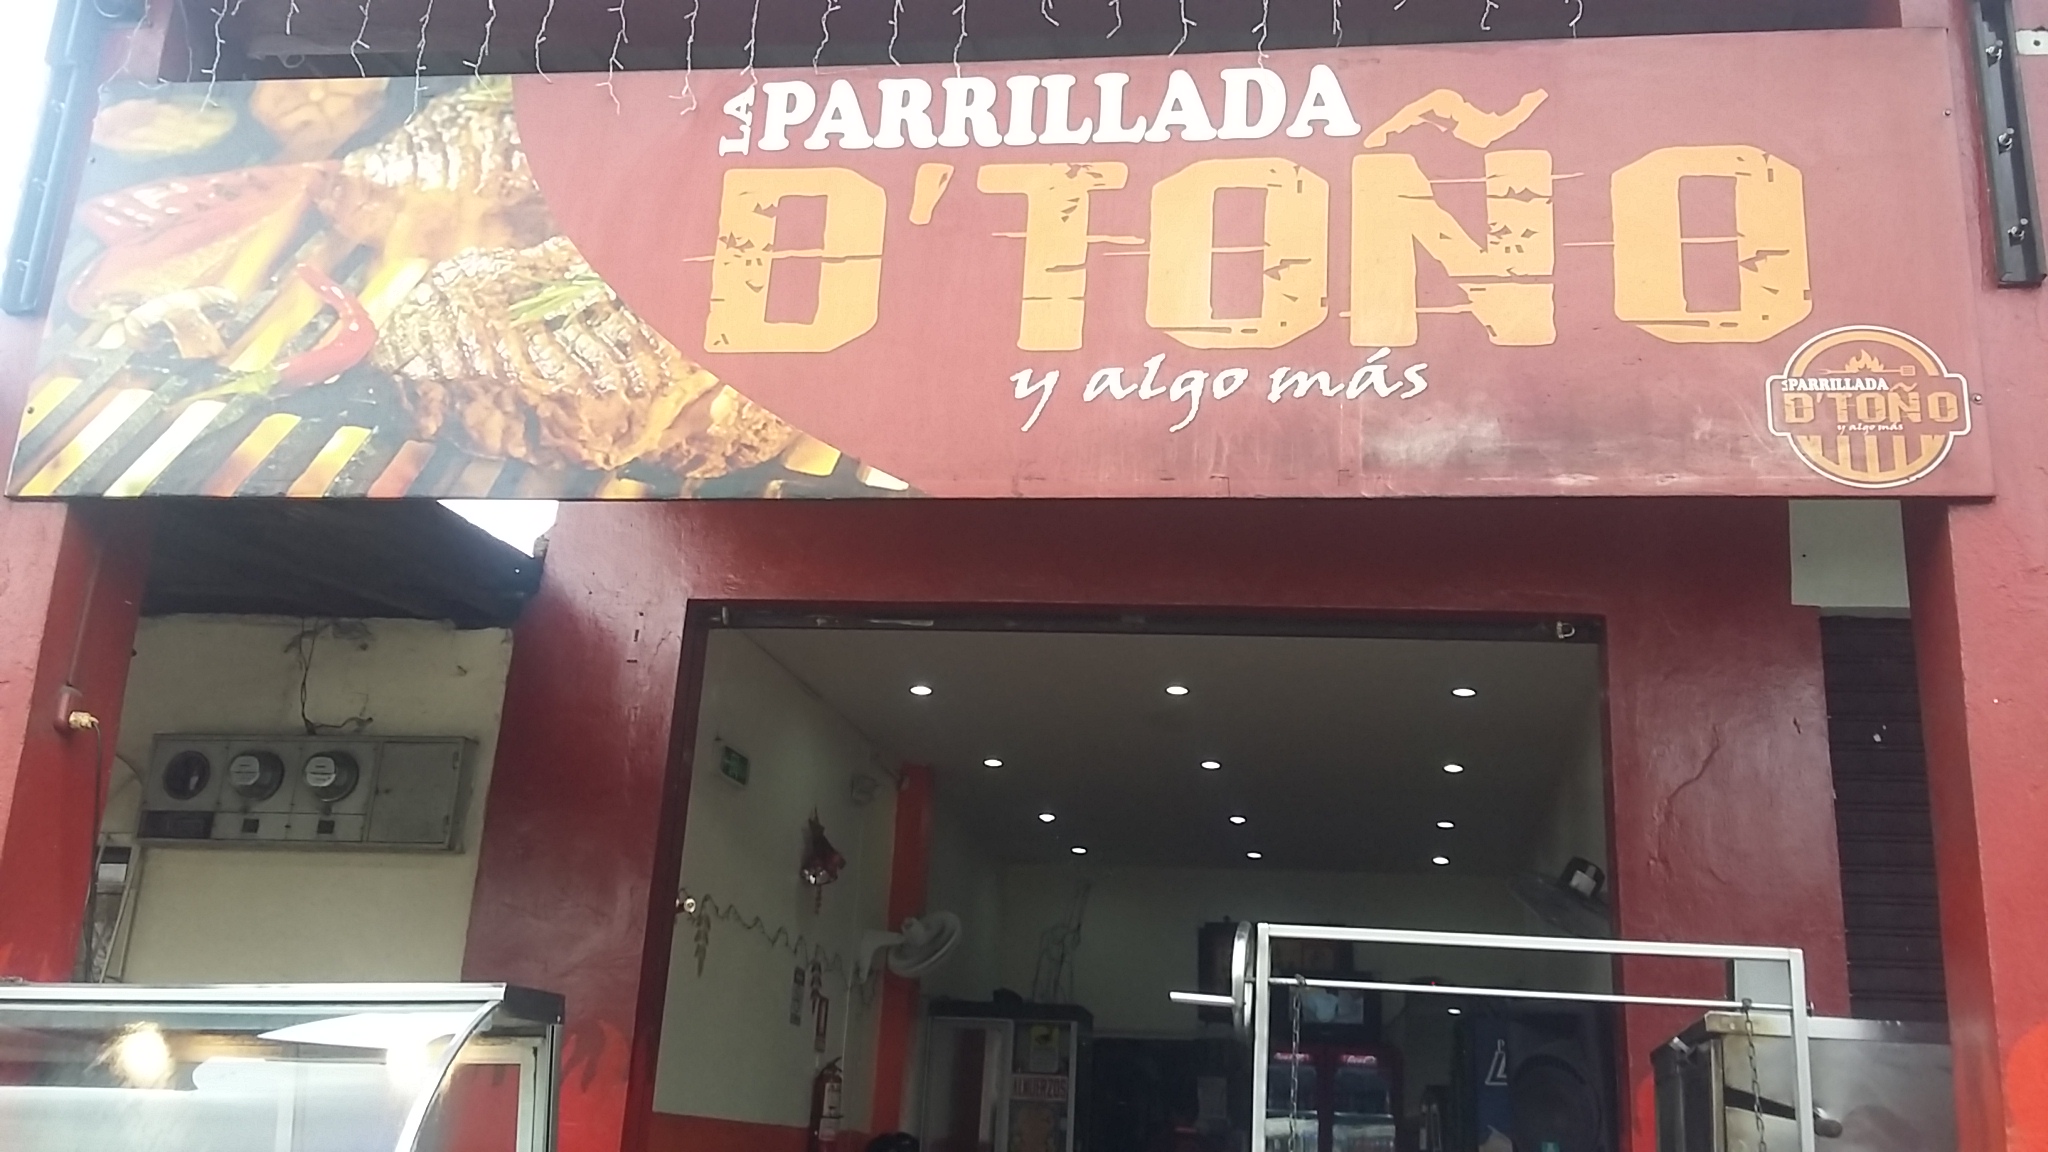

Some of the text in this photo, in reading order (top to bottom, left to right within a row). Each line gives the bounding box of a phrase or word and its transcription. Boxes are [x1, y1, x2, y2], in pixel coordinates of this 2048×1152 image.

[718, 64, 1361, 156] LA PARRILLADA
[703, 87, 1813, 354] D'TOÑO
[1011, 347, 1429, 433] y algo más
[1788, 377, 1890, 391] PARRILLADA
[1836, 421, 1904, 436] y algo más
